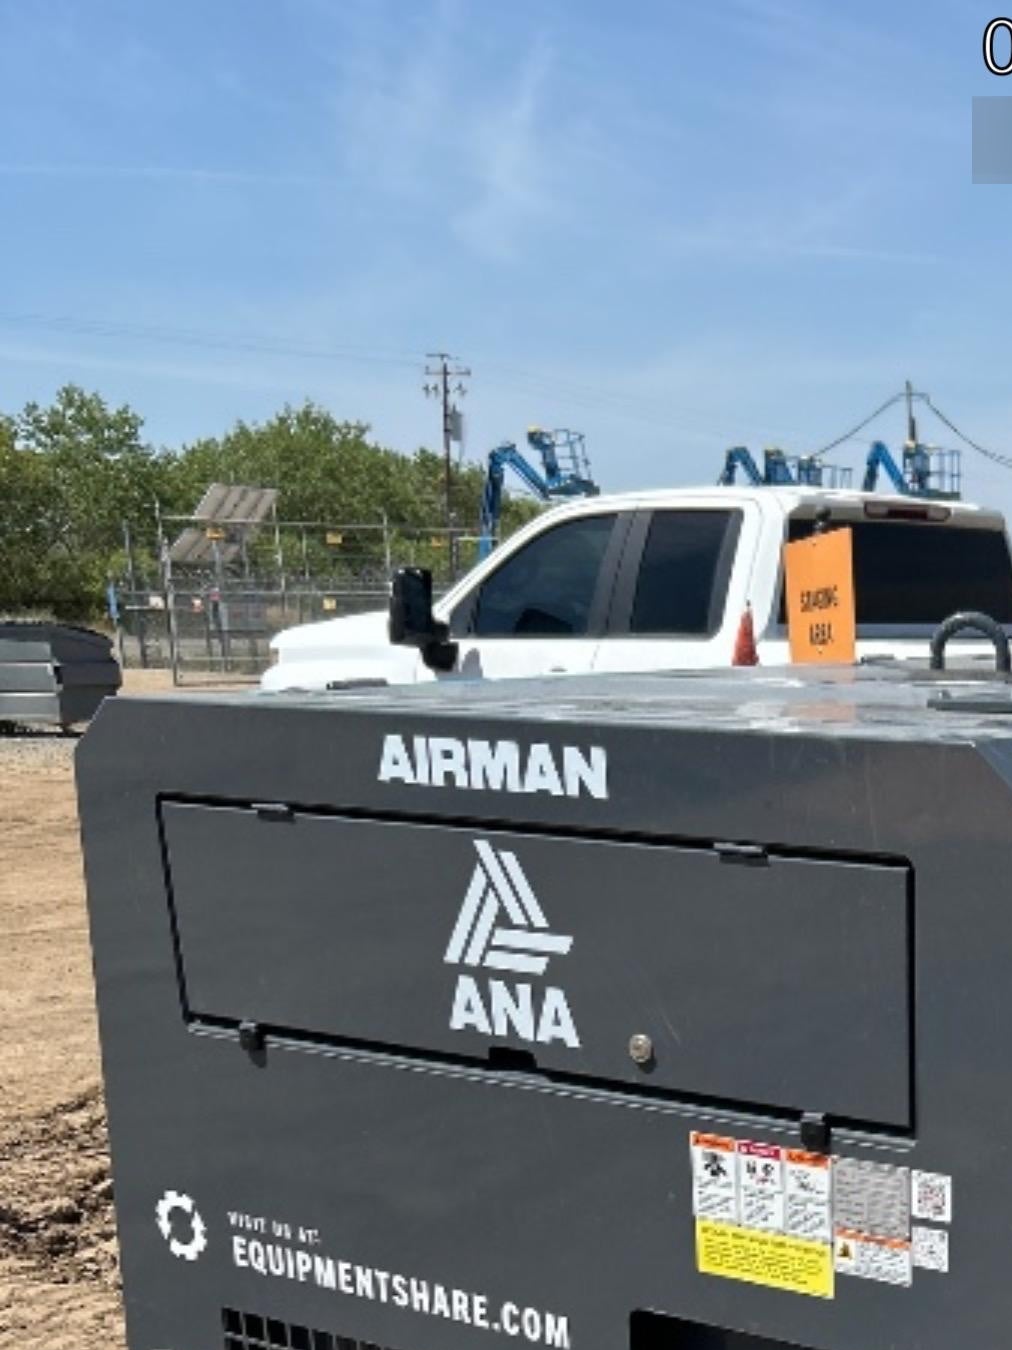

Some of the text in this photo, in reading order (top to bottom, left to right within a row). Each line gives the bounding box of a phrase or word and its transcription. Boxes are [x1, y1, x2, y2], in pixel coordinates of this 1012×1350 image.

[377, 734, 609, 799] AIRMAN
[450, 975, 581, 1048] ANA
[227, 1211, 267, 1233] VISIT
[272, 1219, 292, 1239] US
[232, 1236, 571, 1350] EQUIPMENTSHARE.COM
